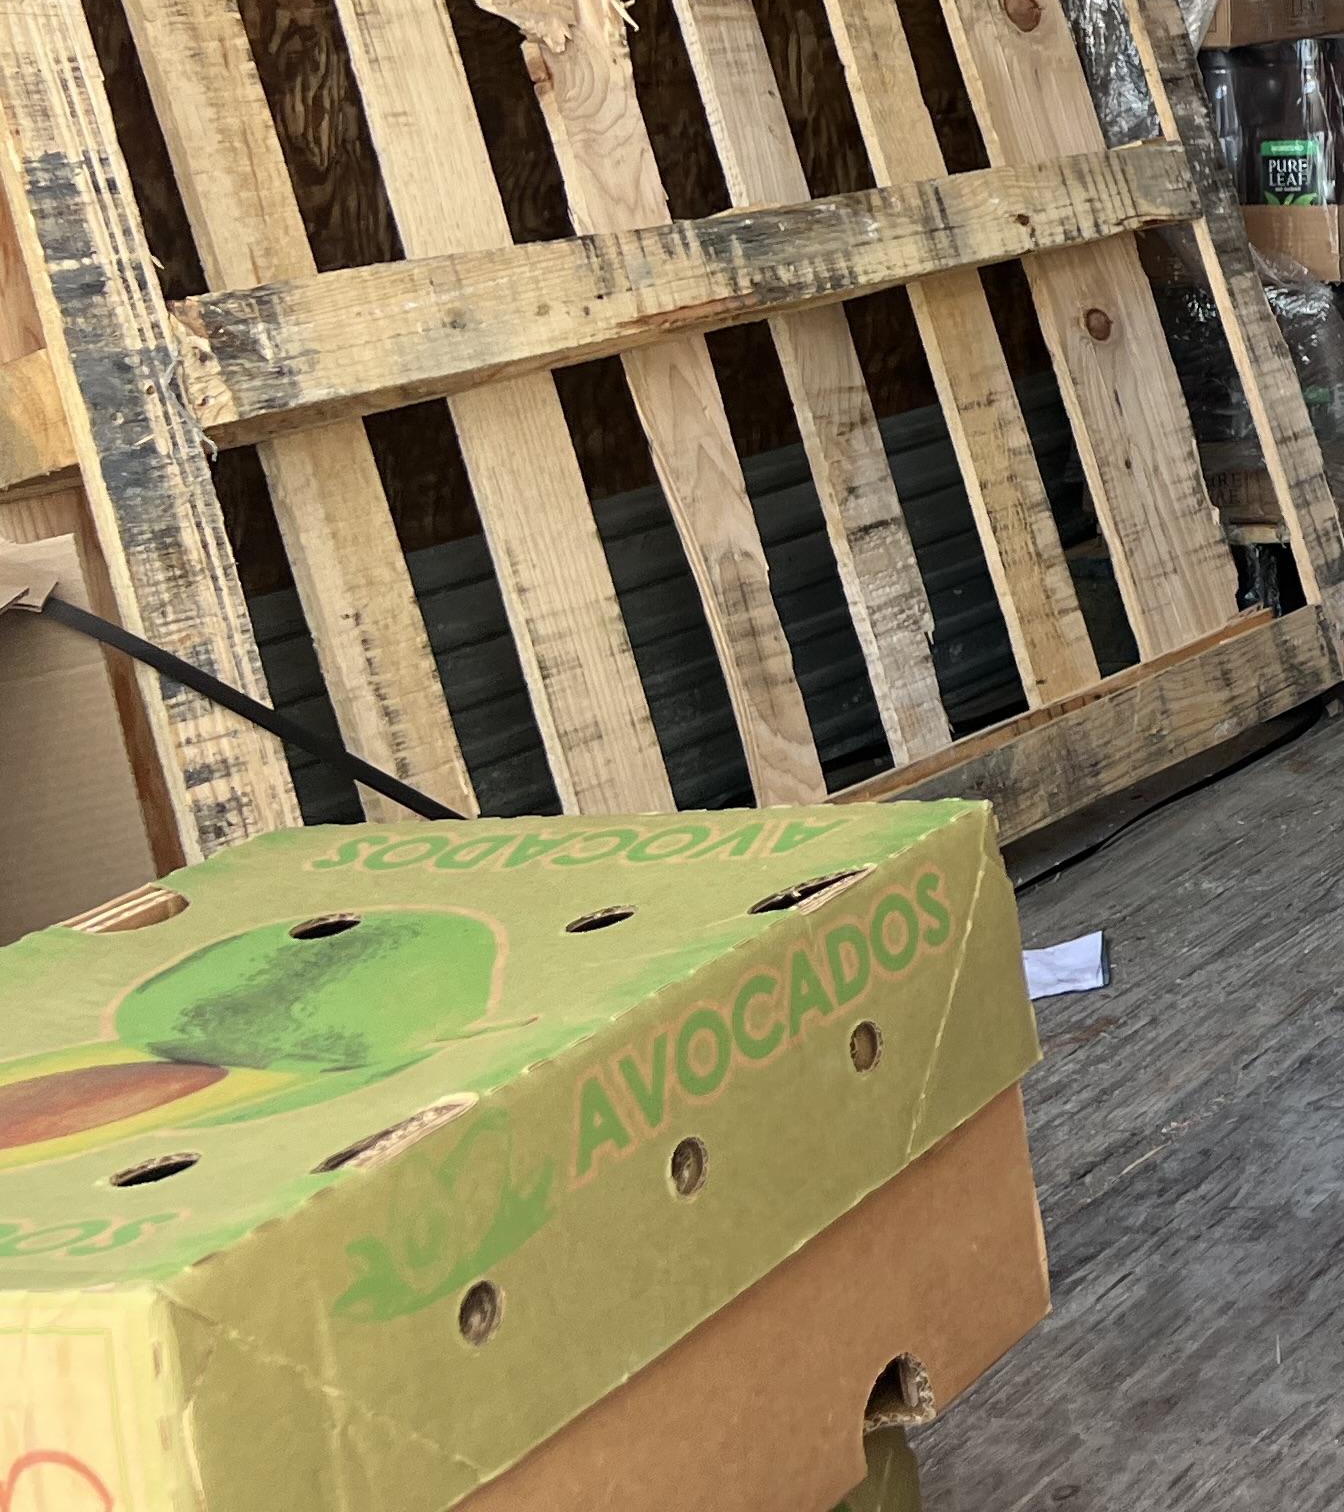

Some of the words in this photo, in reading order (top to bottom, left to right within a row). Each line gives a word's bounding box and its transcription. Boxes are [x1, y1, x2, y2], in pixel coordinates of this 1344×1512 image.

[1268, 159, 1308, 173] PURE
[1269, 173, 1308, 186] LEAF
[312, 817, 850, 872] AVOCADOS
[572, 872, 951, 1176] AVOCADOS
